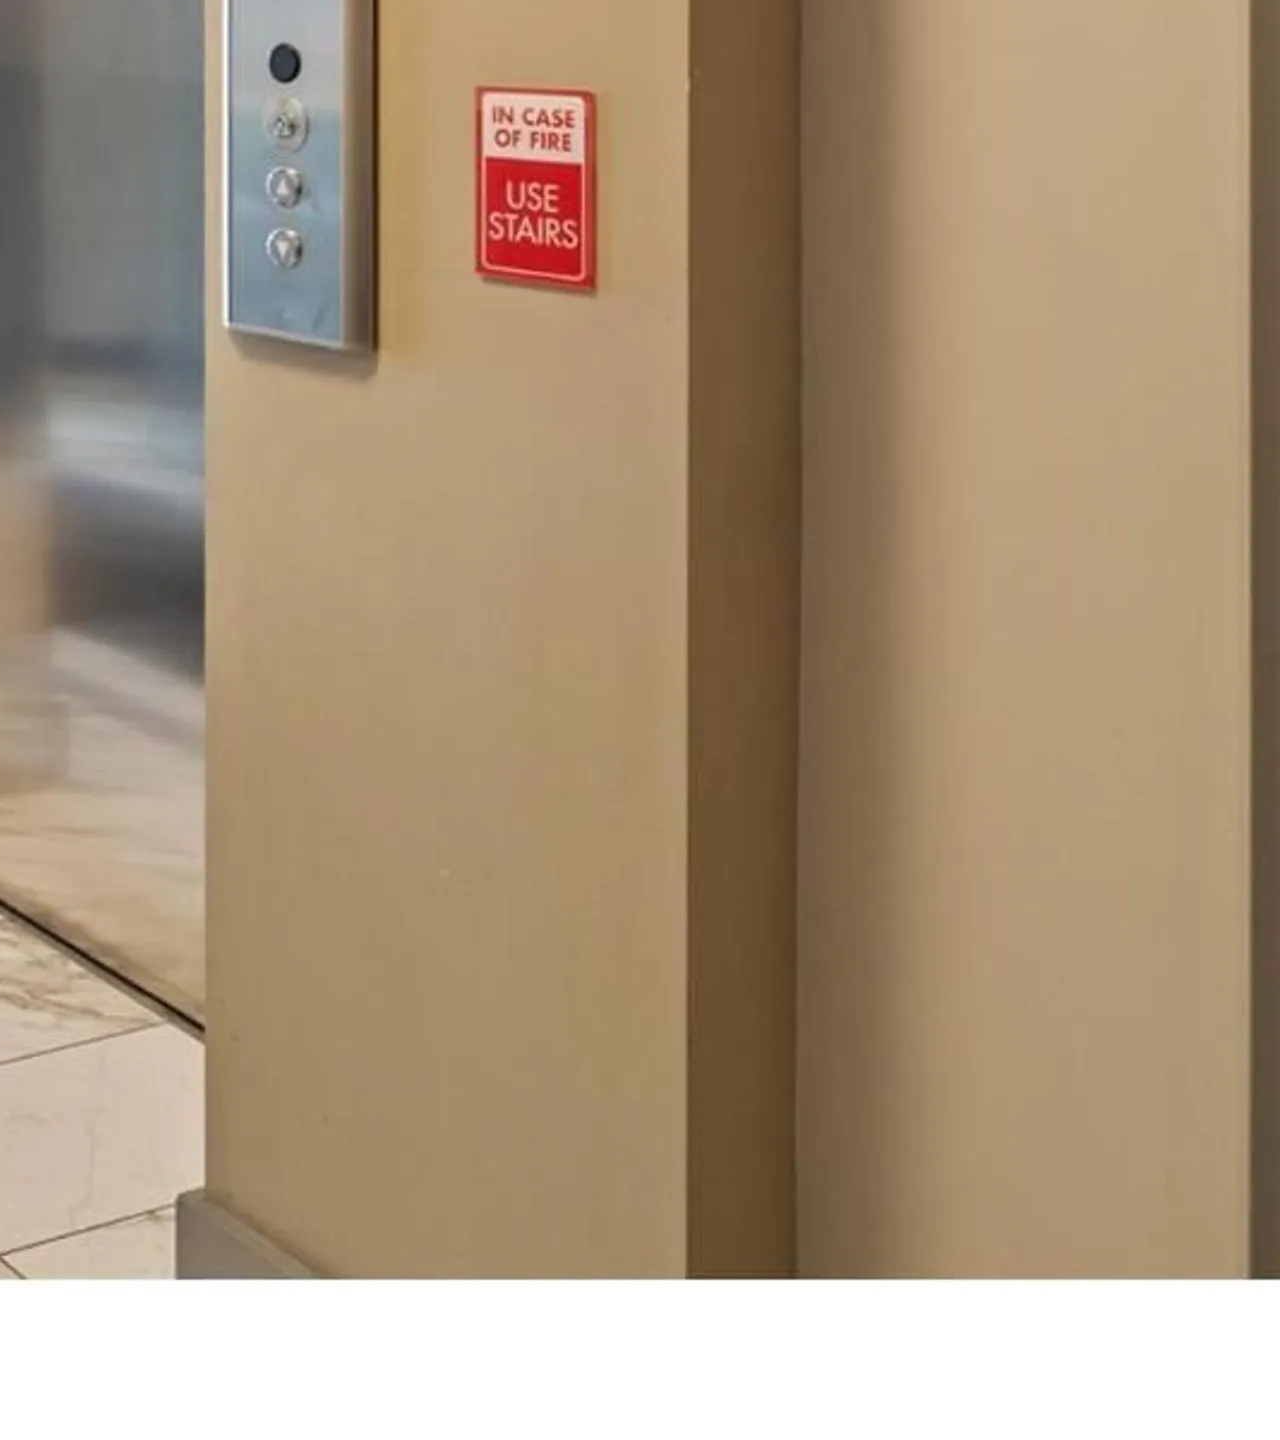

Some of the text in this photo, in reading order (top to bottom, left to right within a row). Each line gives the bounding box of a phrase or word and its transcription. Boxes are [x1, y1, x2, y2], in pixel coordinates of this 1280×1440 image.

[492, 106, 575, 128] IN CASE
[494, 129, 572, 152] OF FIRE
[506, 181, 559, 212] USE
[489, 212, 579, 250] STAIRS
